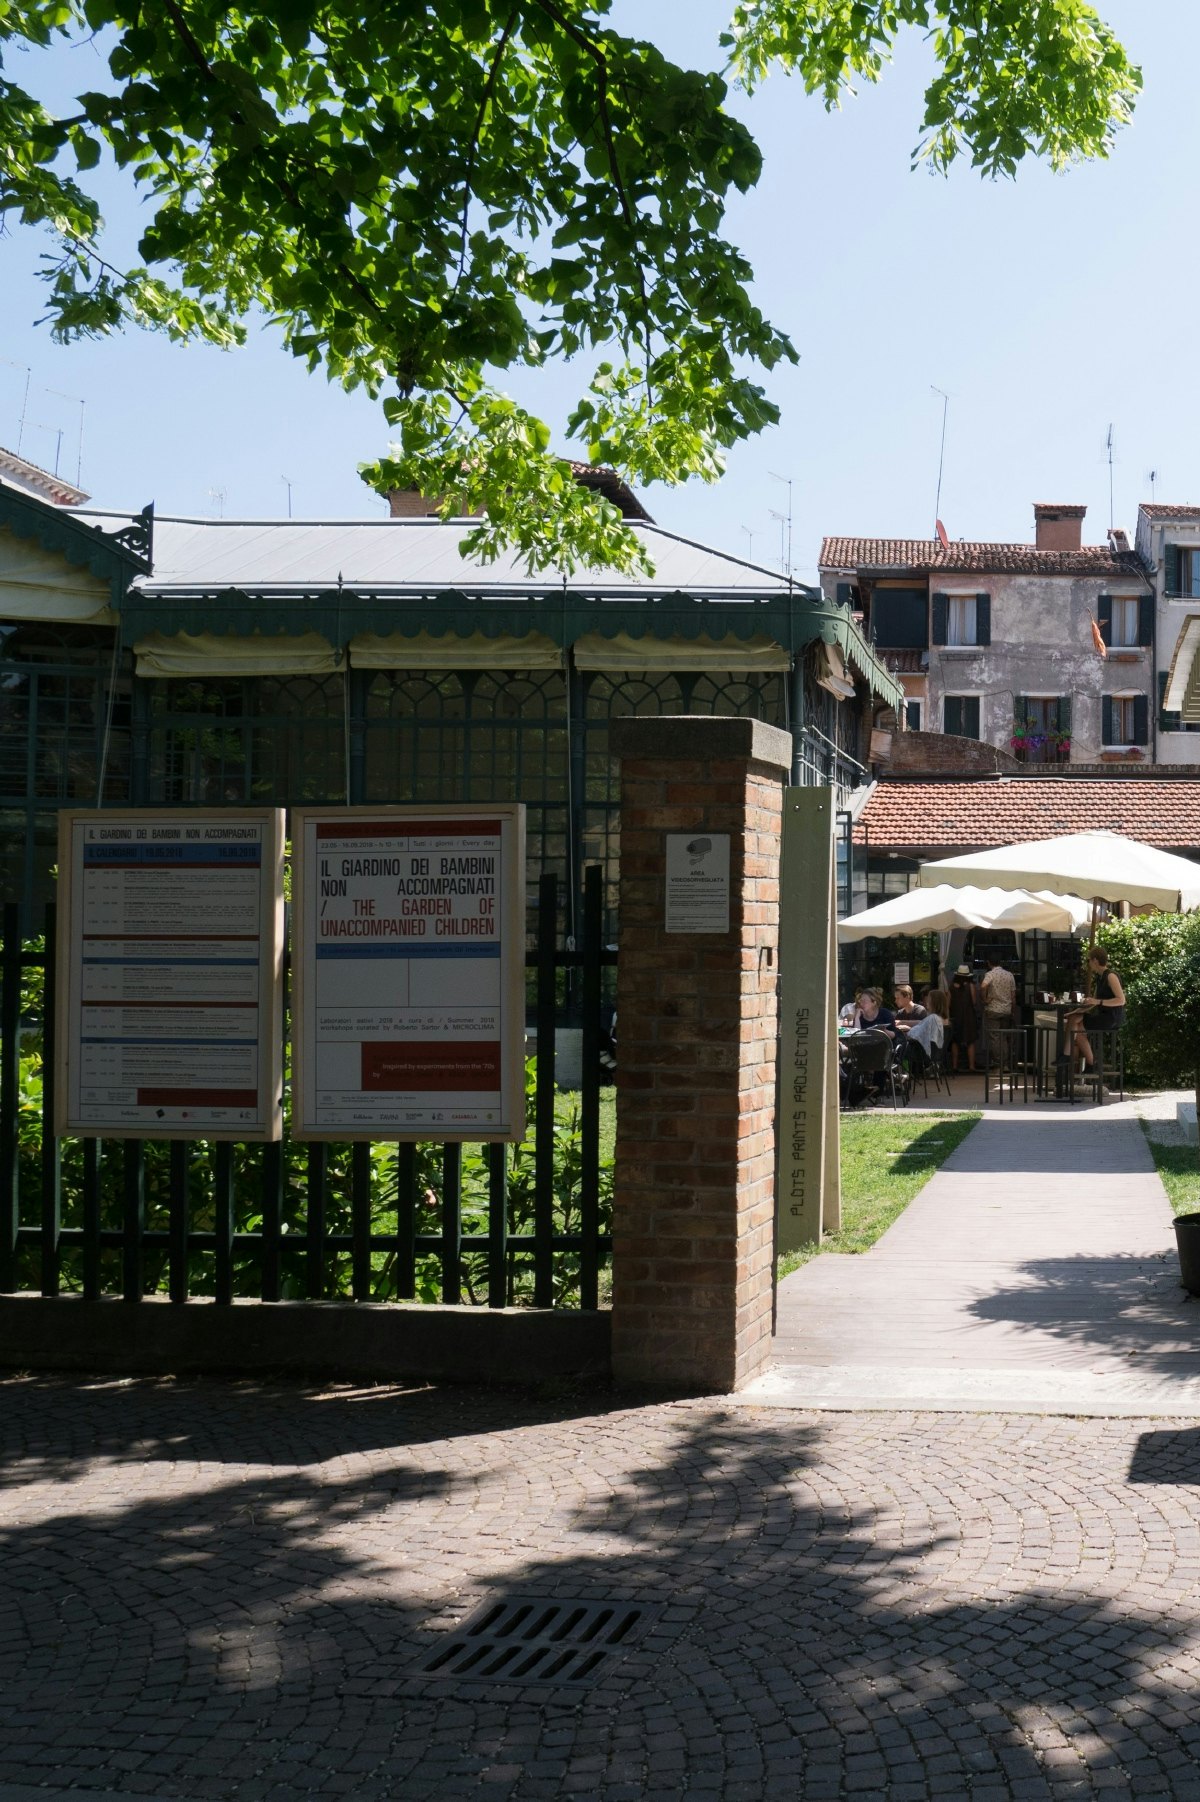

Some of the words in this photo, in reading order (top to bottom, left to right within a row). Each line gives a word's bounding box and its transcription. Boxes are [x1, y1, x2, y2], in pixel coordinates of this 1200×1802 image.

[100, 829, 132, 839] GIARDINO
[152, 829, 181, 839] BAMBINI
[186, 829, 200, 839] NON
[204, 829, 257, 839] ACCOMPAGNATI
[463, 838, 481, 848] Every
[484, 838, 495, 848] day
[321, 859, 331, 877] IL
[342, 858, 400, 877] GIARDINO
[411, 857, 430, 876] DEI
[440, 857, 495, 875] BAMBINI
[321, 879, 347, 897] NON
[397, 877, 495, 896] ACCOMPAGNATI
[320, 899, 328, 917] /
[352, 899, 376, 916] THE
[402, 898, 452, 916] GARDEN
[478, 897, 495, 915] OF
[321, 918, 426, 937] UNACCOMPANIED
[435, 917, 494, 936] CHILDREN
[320, 1024, 354, 1032] workshops
[382, 1024, 390, 1032] by
[393, 1023, 418, 1031] Roberto
[452, 1023, 495, 1031] MICROCLIMA
[794, 1007, 810, 1103] PROJECTIONS
[416, 1063, 455, 1071] experiments
[455, 1063, 471, 1071] from
[792, 1110, 807, 1161] PRINTS
[790, 1169, 806, 1217] PLOTS
